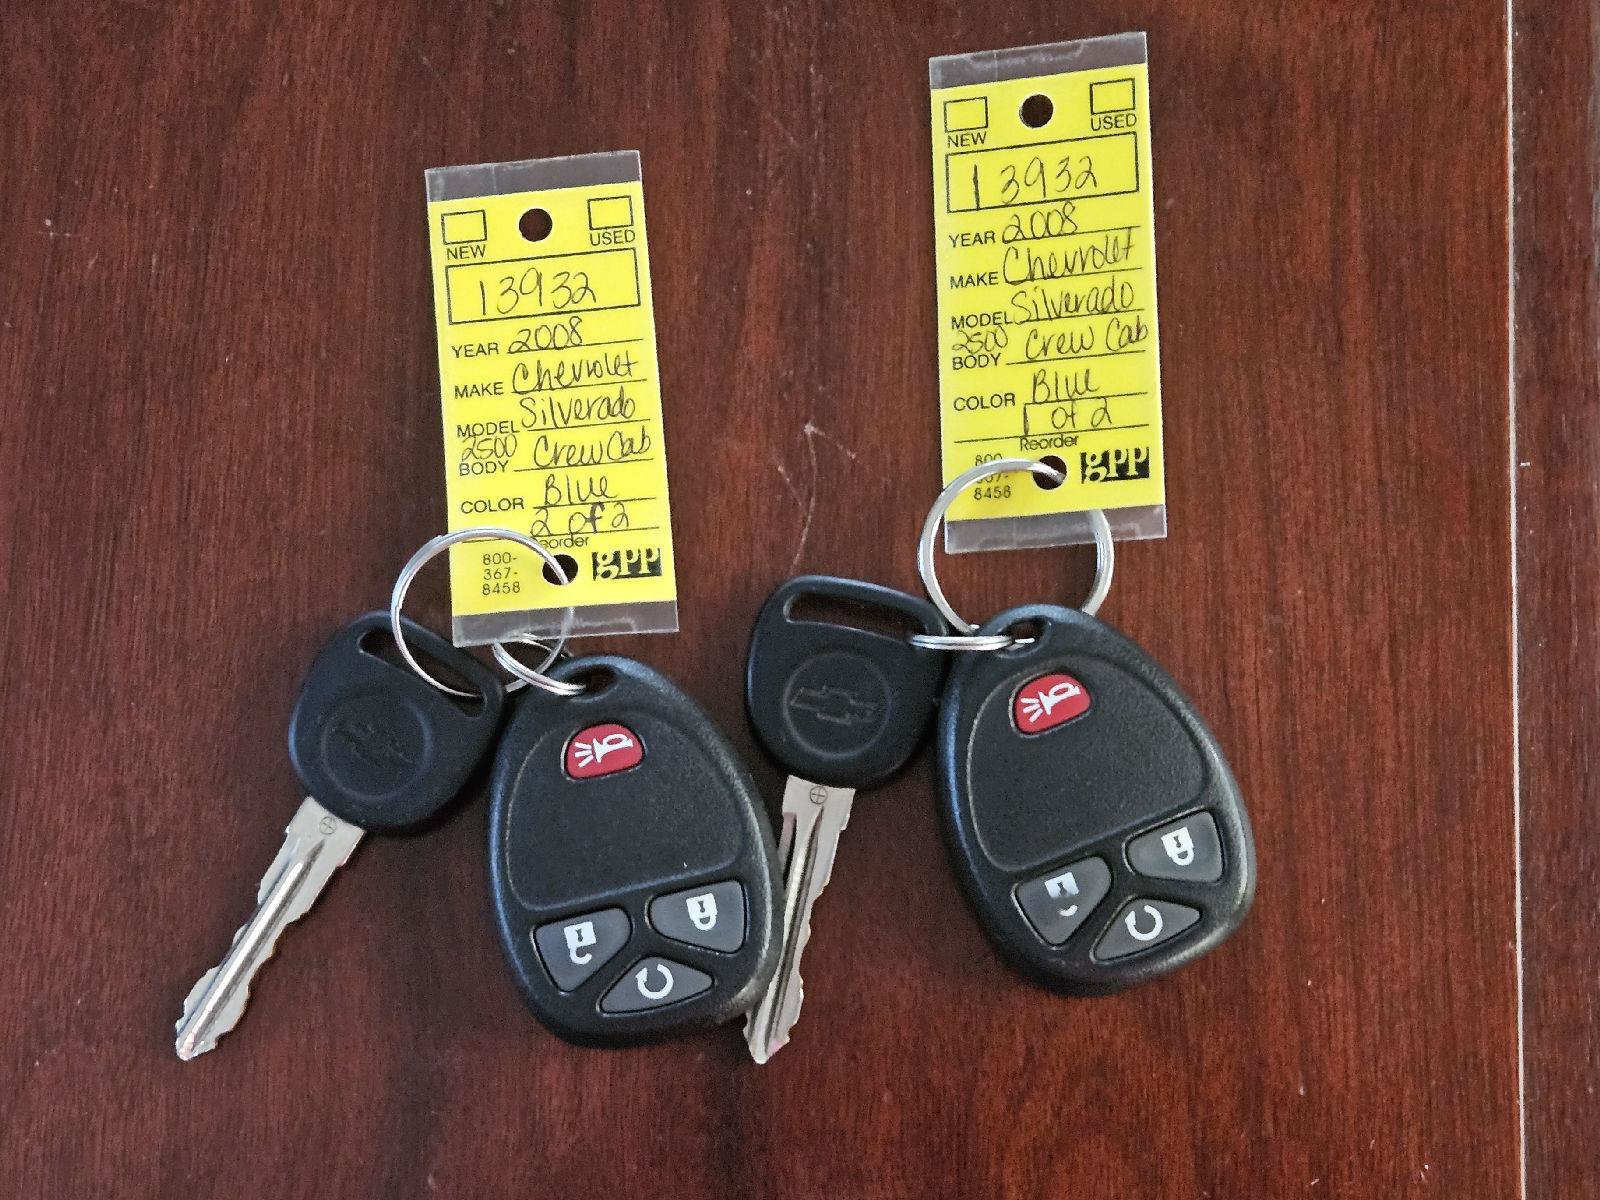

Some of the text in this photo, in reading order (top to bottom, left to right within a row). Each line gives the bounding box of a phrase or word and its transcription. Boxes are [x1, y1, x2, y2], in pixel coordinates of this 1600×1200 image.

[1091, 113, 1137, 131] USED
[948, 131, 987, 148] NEW
[973, 156, 1097, 210] 13932
[1002, 202, 1078, 244] 2008
[590, 230, 635, 246] USED
[949, 231, 996, 248] YEAR
[447, 244, 487, 260] NEW
[1003, 228, 1135, 285] Chevrolet
[950, 272, 999, 289] MAKE
[480, 268, 597, 315] 13932
[1011, 275, 1134, 325] Silverado
[951, 312, 1014, 330] MODEL
[507, 316, 583, 354] 2008
[952, 325, 1008, 355] 2500
[1106, 315, 1149, 351] Cab
[451, 342, 499, 358] YEAR
[952, 353, 1001, 370] BODY
[512, 351, 638, 394] Chevrolet
[454, 382, 504, 398] MAKE
[1033, 368, 1101, 403] Blue
[520, 386, 635, 428] Silverado
[954, 393, 1016, 411] COLOR
[1022, 404, 1030, 436] 1
[1090, 398, 1112, 427] 2
[457, 420, 519, 438] MODEL
[462, 425, 651, 469] 2500 Crew Cab
[1020, 435, 1079, 451] Reorder
[459, 461, 509, 476] BODY
[1080, 447, 1150, 484] gpp
[544, 473, 618, 507] Blue
[461, 498, 524, 514] COLOR
[530, 501, 629, 538] 2 of 2
[532, 536, 590, 549] eorder
[483, 552, 518, 565] 800-
[592, 548, 662, 581] gpp
[483, 568, 518, 580] 367-
[483, 582, 521, 596] 8458
